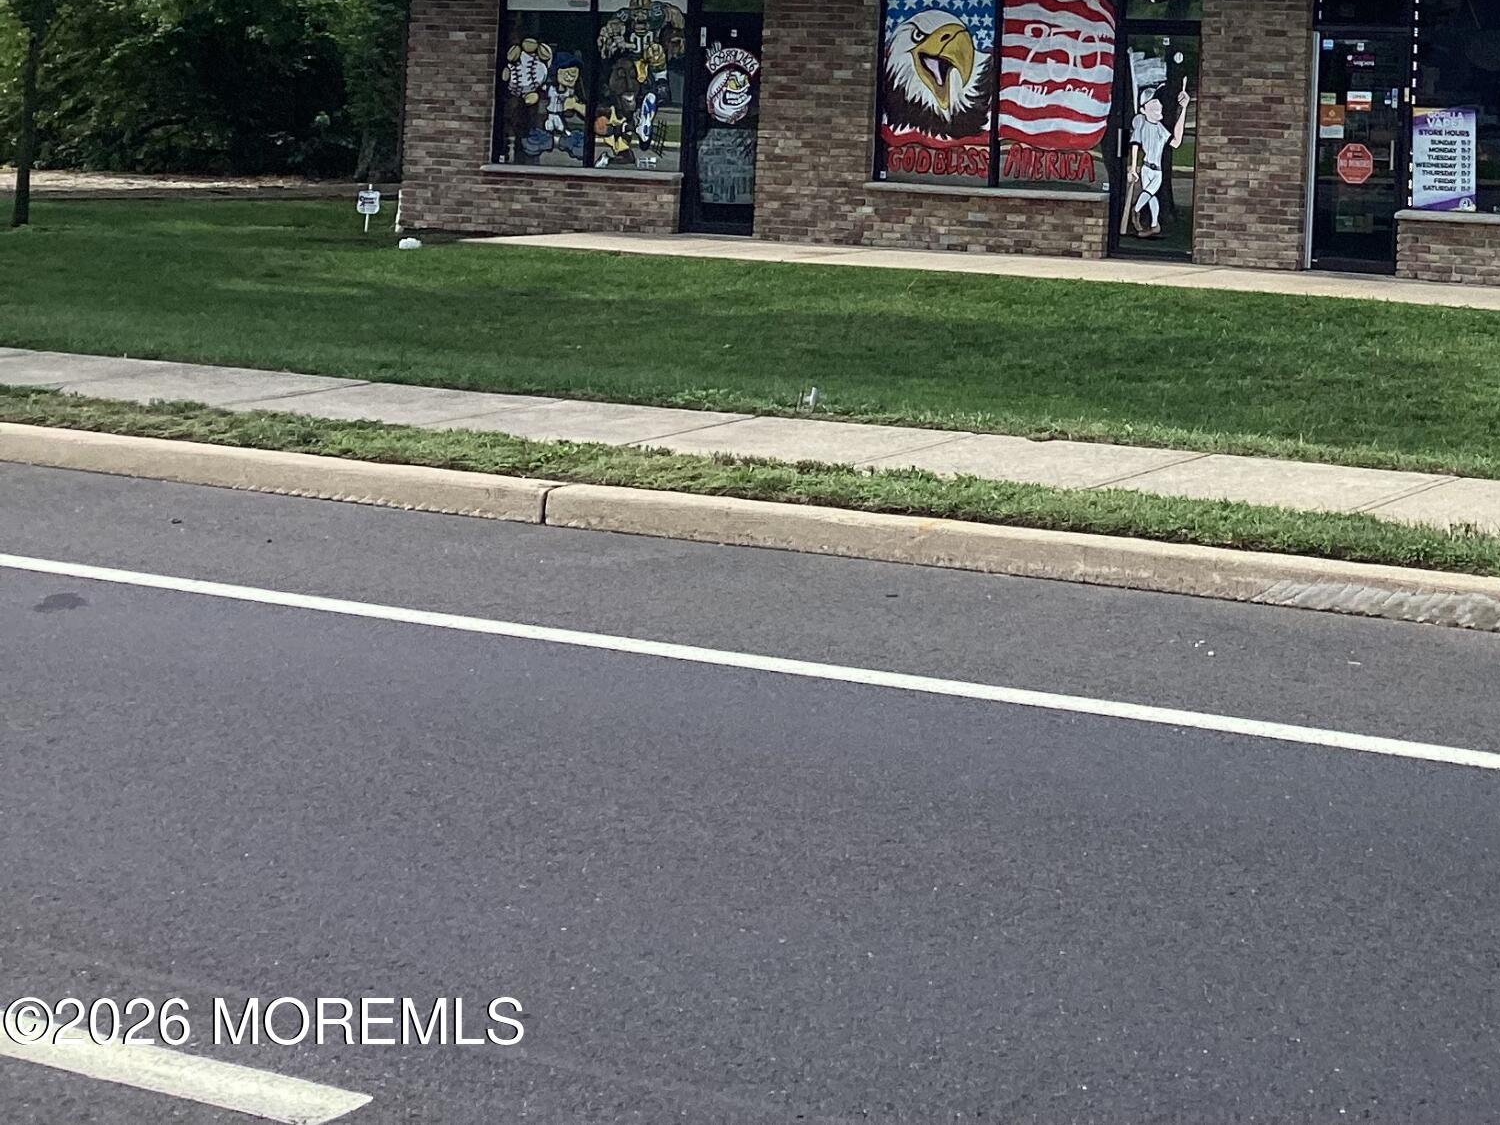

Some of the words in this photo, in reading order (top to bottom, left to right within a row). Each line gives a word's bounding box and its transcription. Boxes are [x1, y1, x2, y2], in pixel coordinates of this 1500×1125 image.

[1444, 129, 1470, 137] HOURS
[888, 146, 931, 174] GOD
[932, 146, 989, 178] BLESS
[1004, 143, 1095, 183] AMERICA
